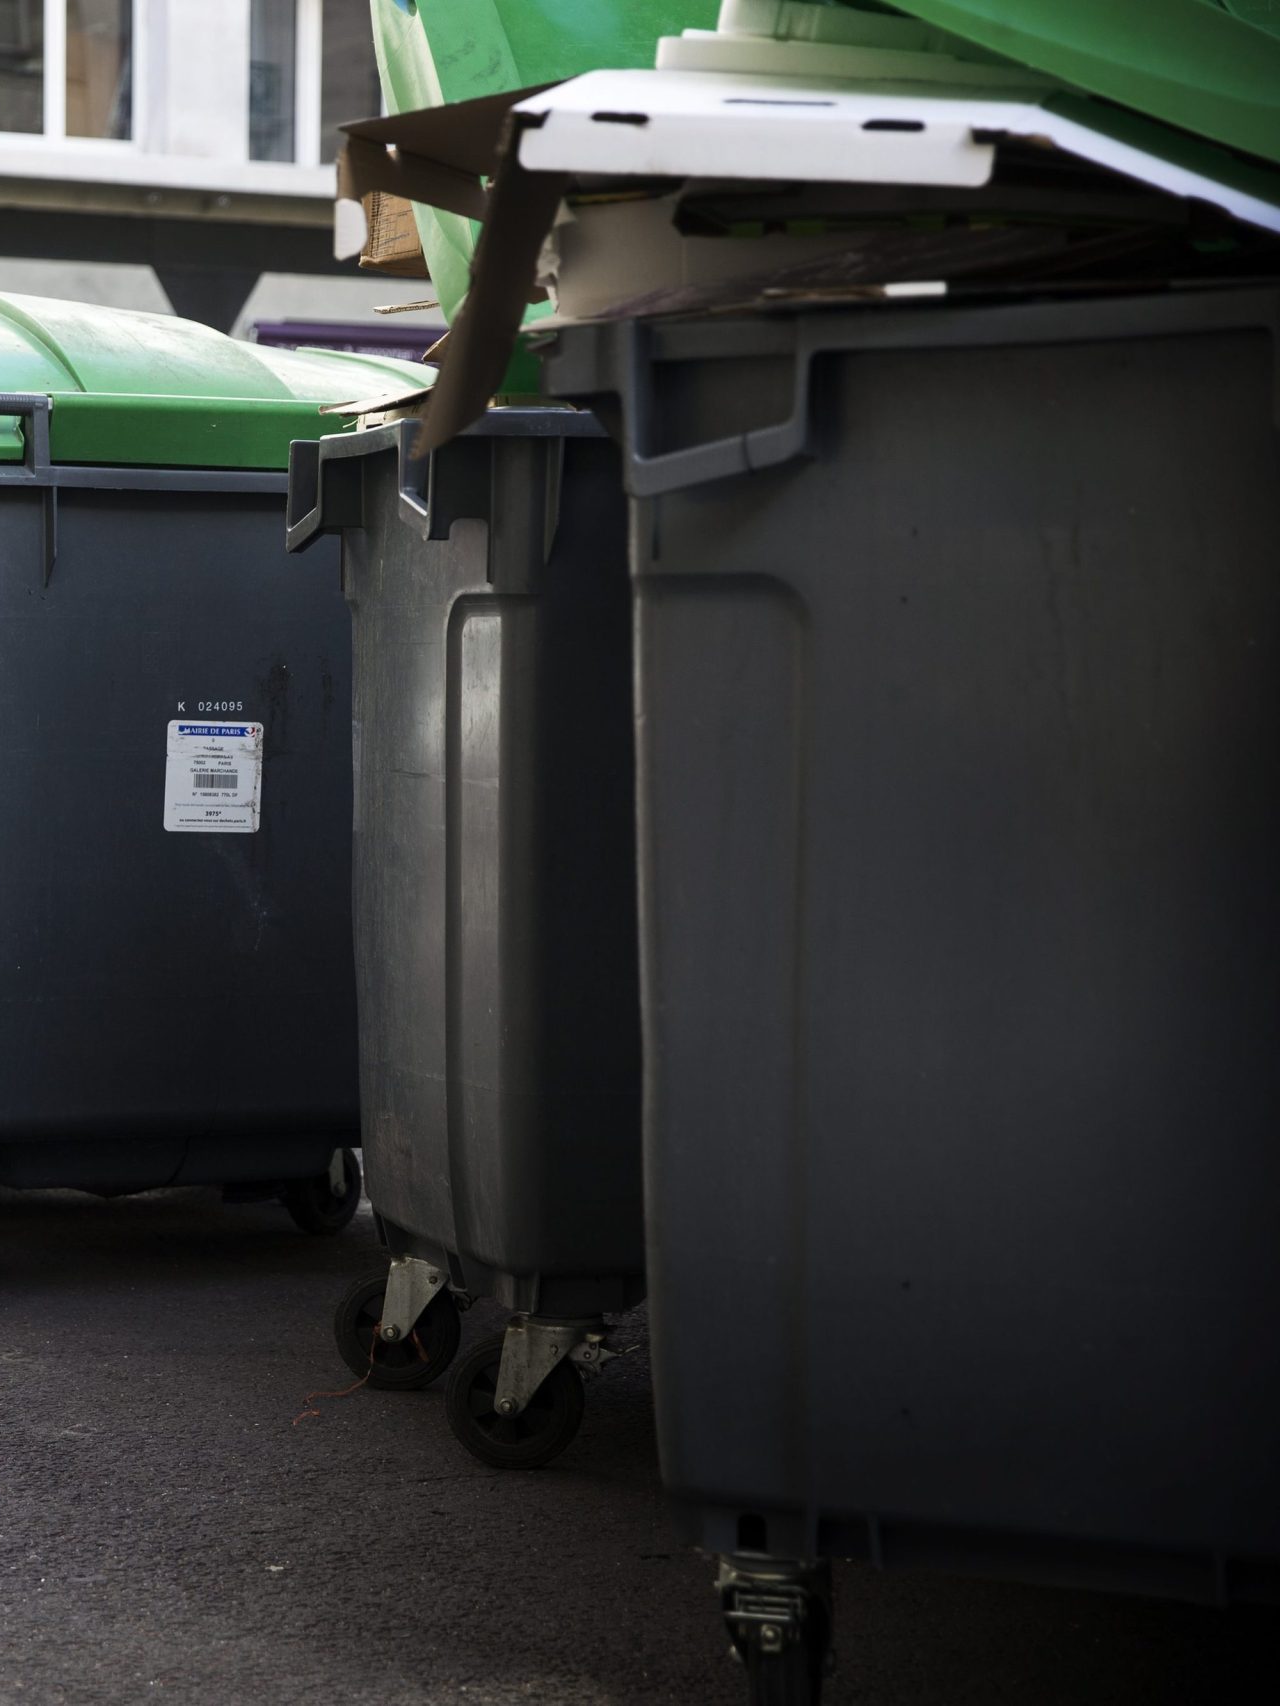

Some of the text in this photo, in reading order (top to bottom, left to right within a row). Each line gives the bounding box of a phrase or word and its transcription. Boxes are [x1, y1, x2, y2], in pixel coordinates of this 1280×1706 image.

[177, 701, 243, 712] K 024095
[184, 727, 209, 735] MAIRIE
[221, 728, 241, 736] PARIS
